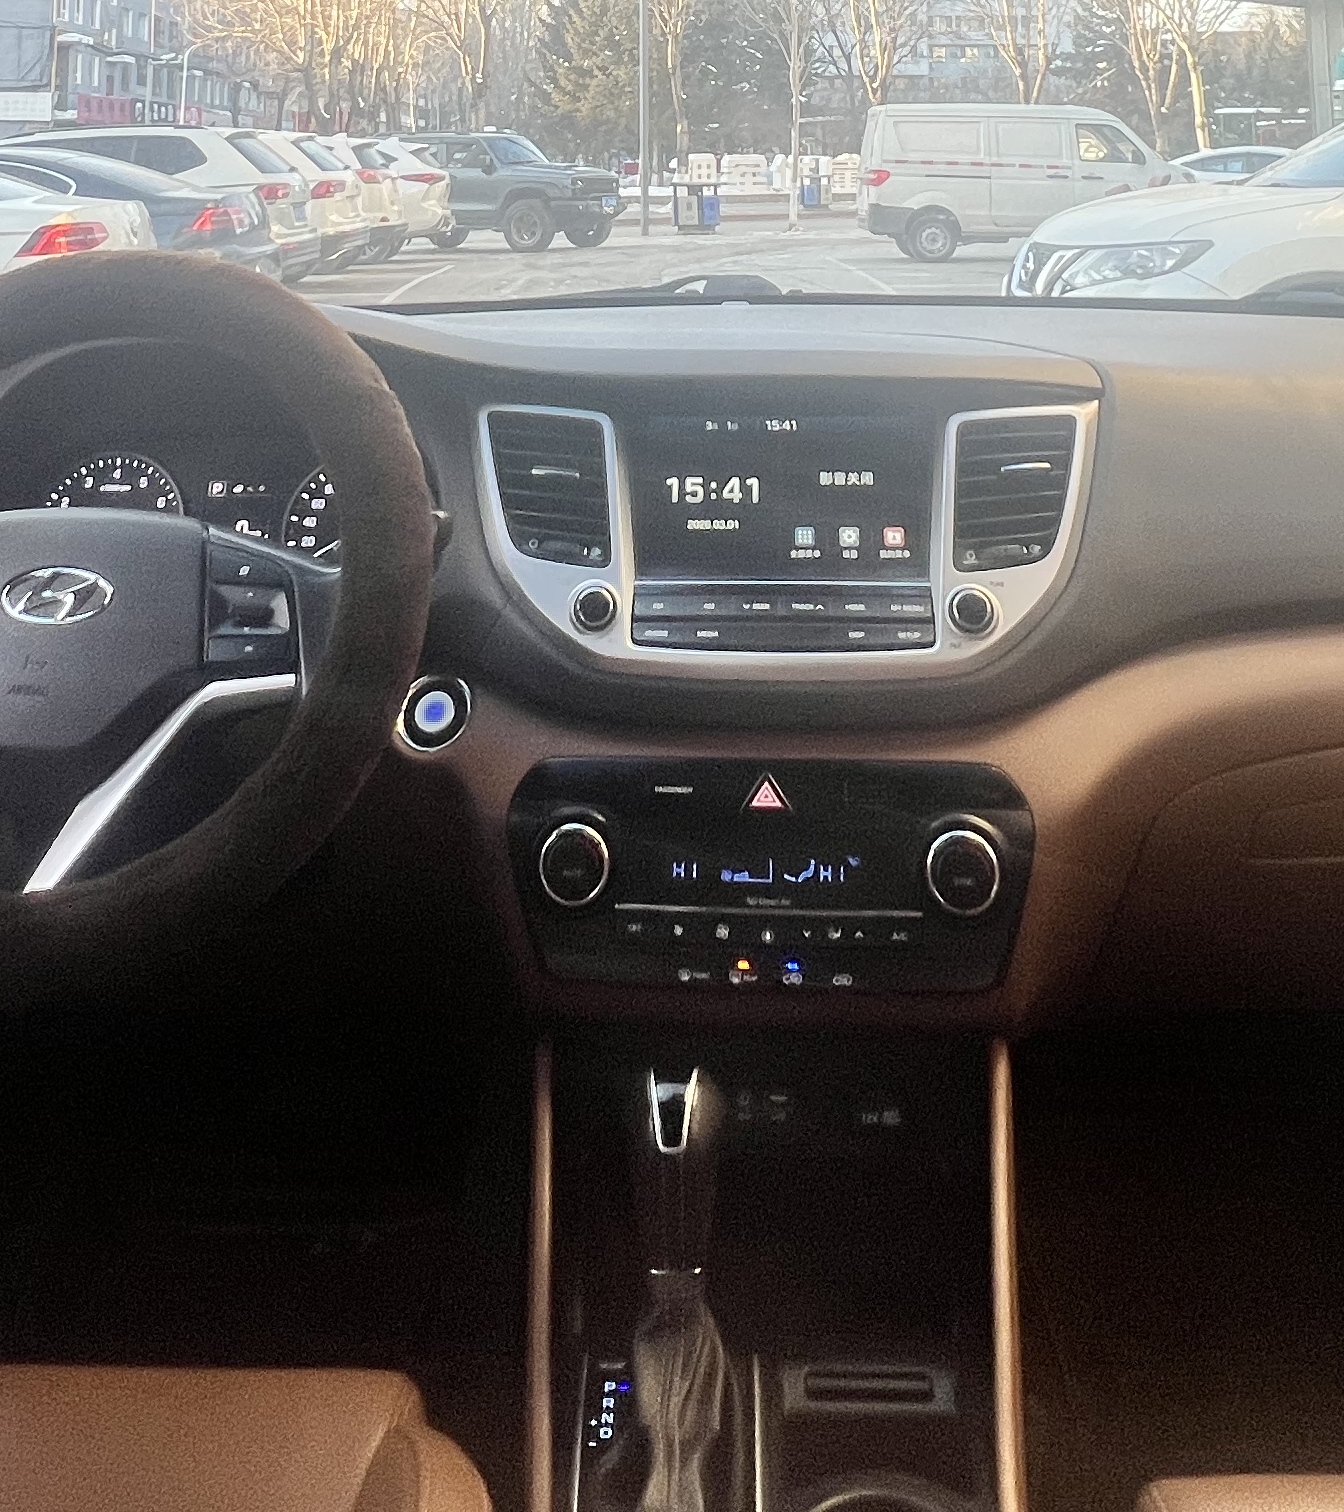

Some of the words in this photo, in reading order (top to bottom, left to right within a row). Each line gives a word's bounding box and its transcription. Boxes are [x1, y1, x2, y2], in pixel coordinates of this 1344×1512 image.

[765, 419, 798, 432] 15:41
[665, 476, 761, 504] 15:41
[301, 536, 316, 548] 20
[672, 860, 698, 878] HI
[819, 864, 845, 883] HI
[604, 1381, 616, 1393] P
[600, 1412, 614, 1424] N
